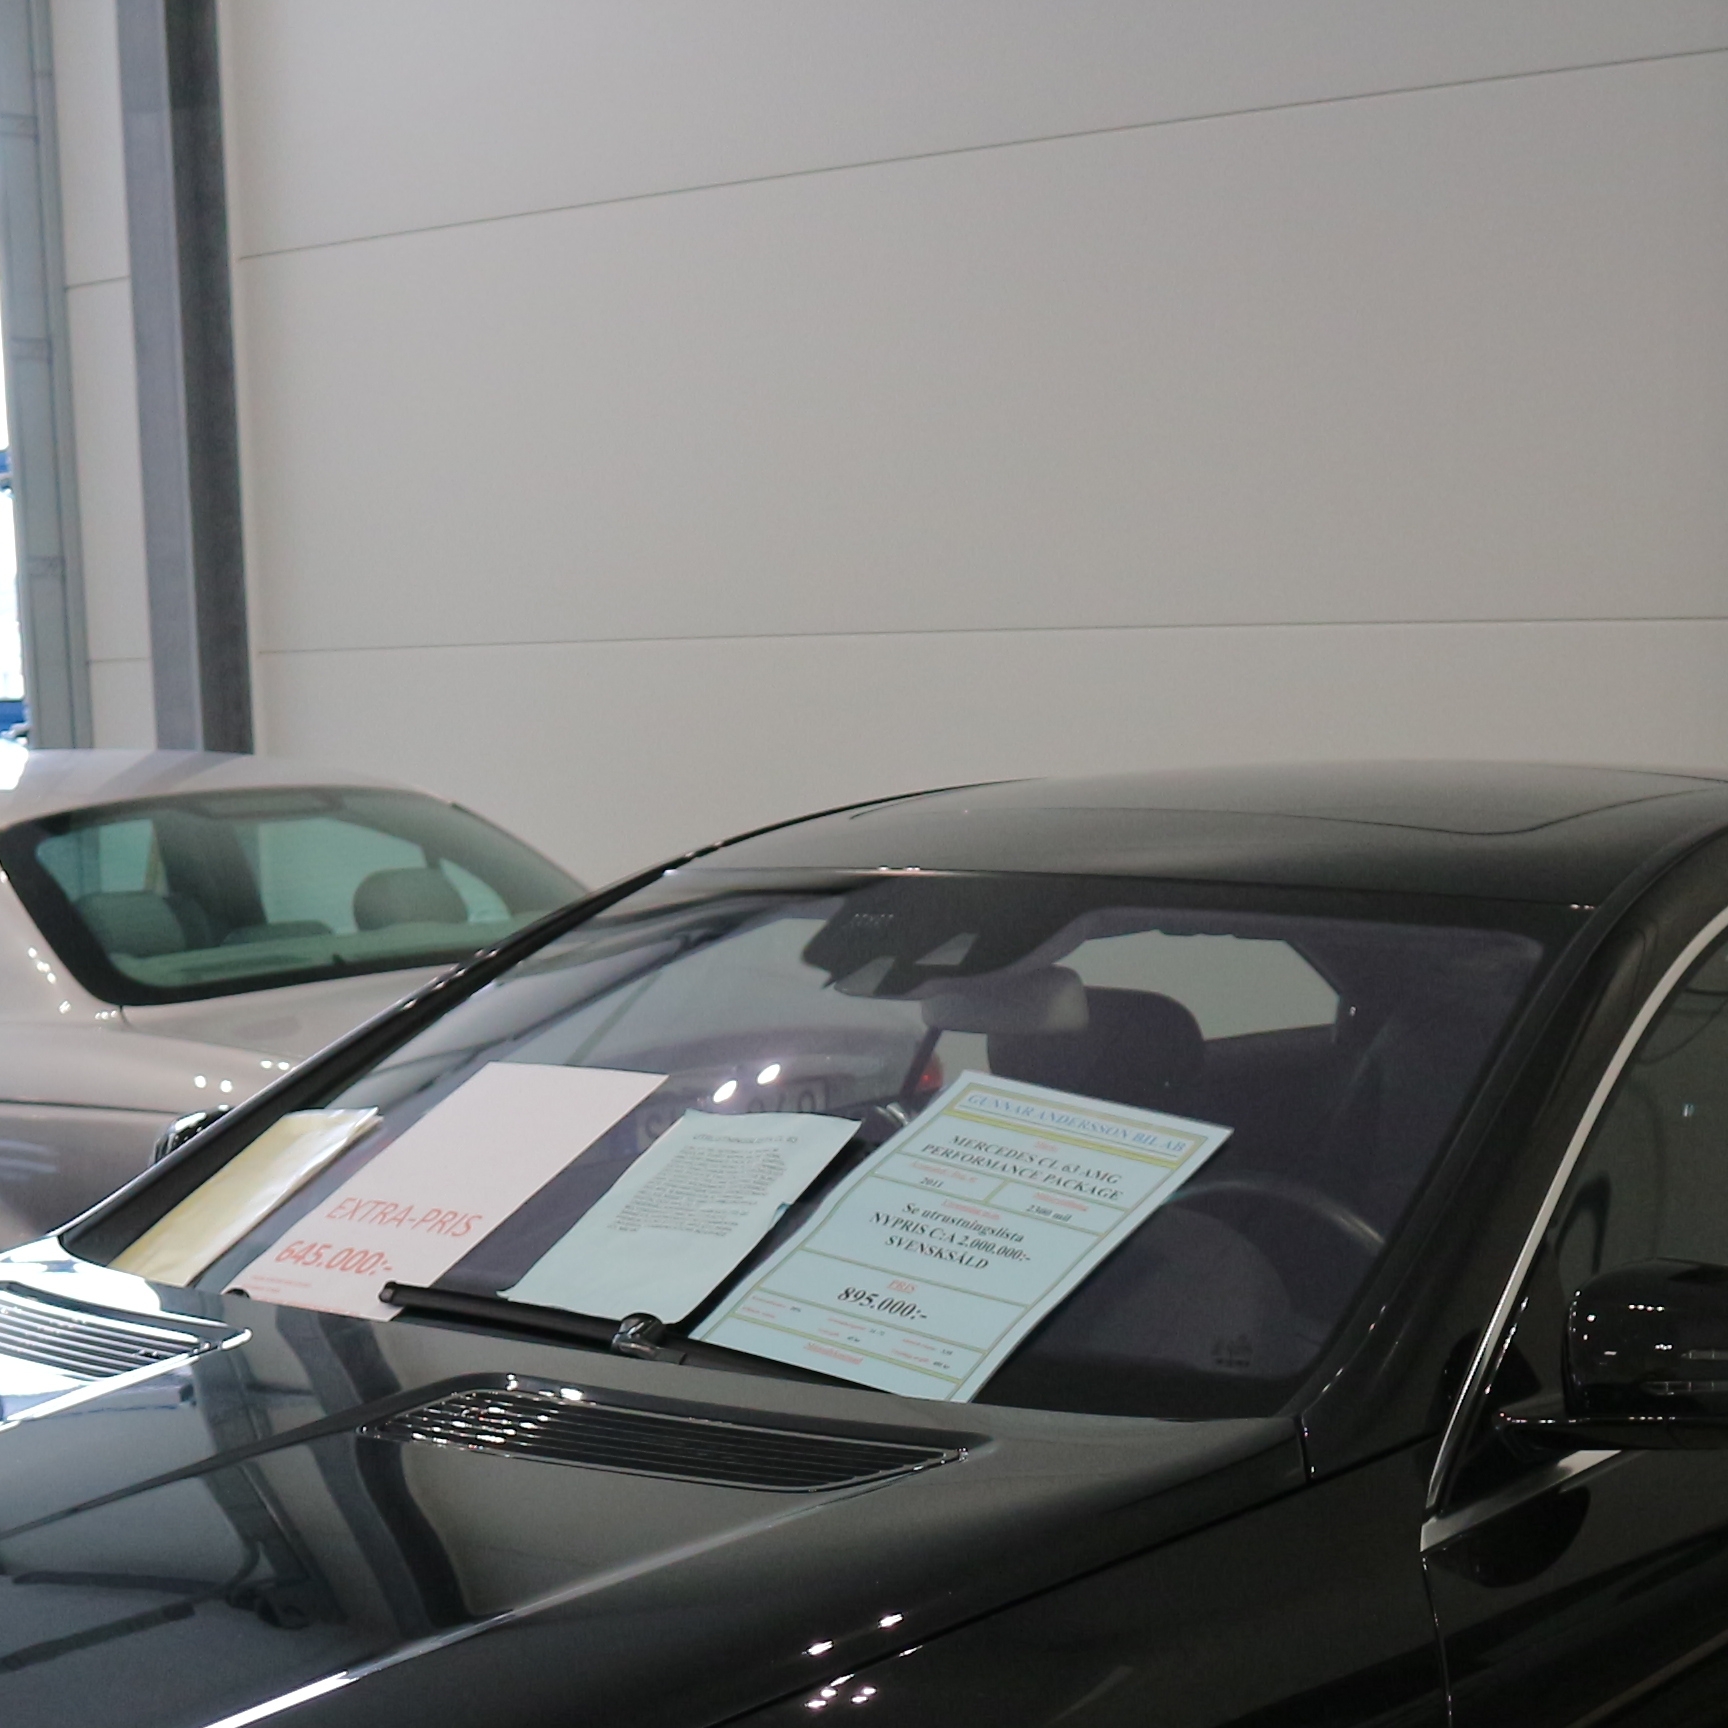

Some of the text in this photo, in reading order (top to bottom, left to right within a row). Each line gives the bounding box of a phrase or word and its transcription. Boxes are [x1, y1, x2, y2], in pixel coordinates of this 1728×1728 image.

[968, 1093, 1187, 1153] GUNNAR ANDERSSON BIL AB
[922, 1143, 1043, 1181] PERFORMANCE
[1043, 1173, 1125, 1202] PACKAGE
[950, 1135, 1038, 1164] MERCEDES
[1038, 1156, 1059, 1170] CL
[1061, 1162, 1081, 1173] 63
[1082, 1166, 1122, 1185] AMG
[920, 1176, 944, 1189] 2011
[325, 1197, 483, 1238] EXTRA-PRIS
[869, 1212, 927, 1235] NYPRIS
[901, 1202, 920, 1215] Se
[921, 1208, 1025, 1243] utrustningslista
[274, 1239, 394, 1277] 645.000:-
[885, 1235, 989, 1270] SVENSKSÅLD
[836, 1286, 928, 1321] 895.000:-
[887, 1279, 917, 1293] PRIS
